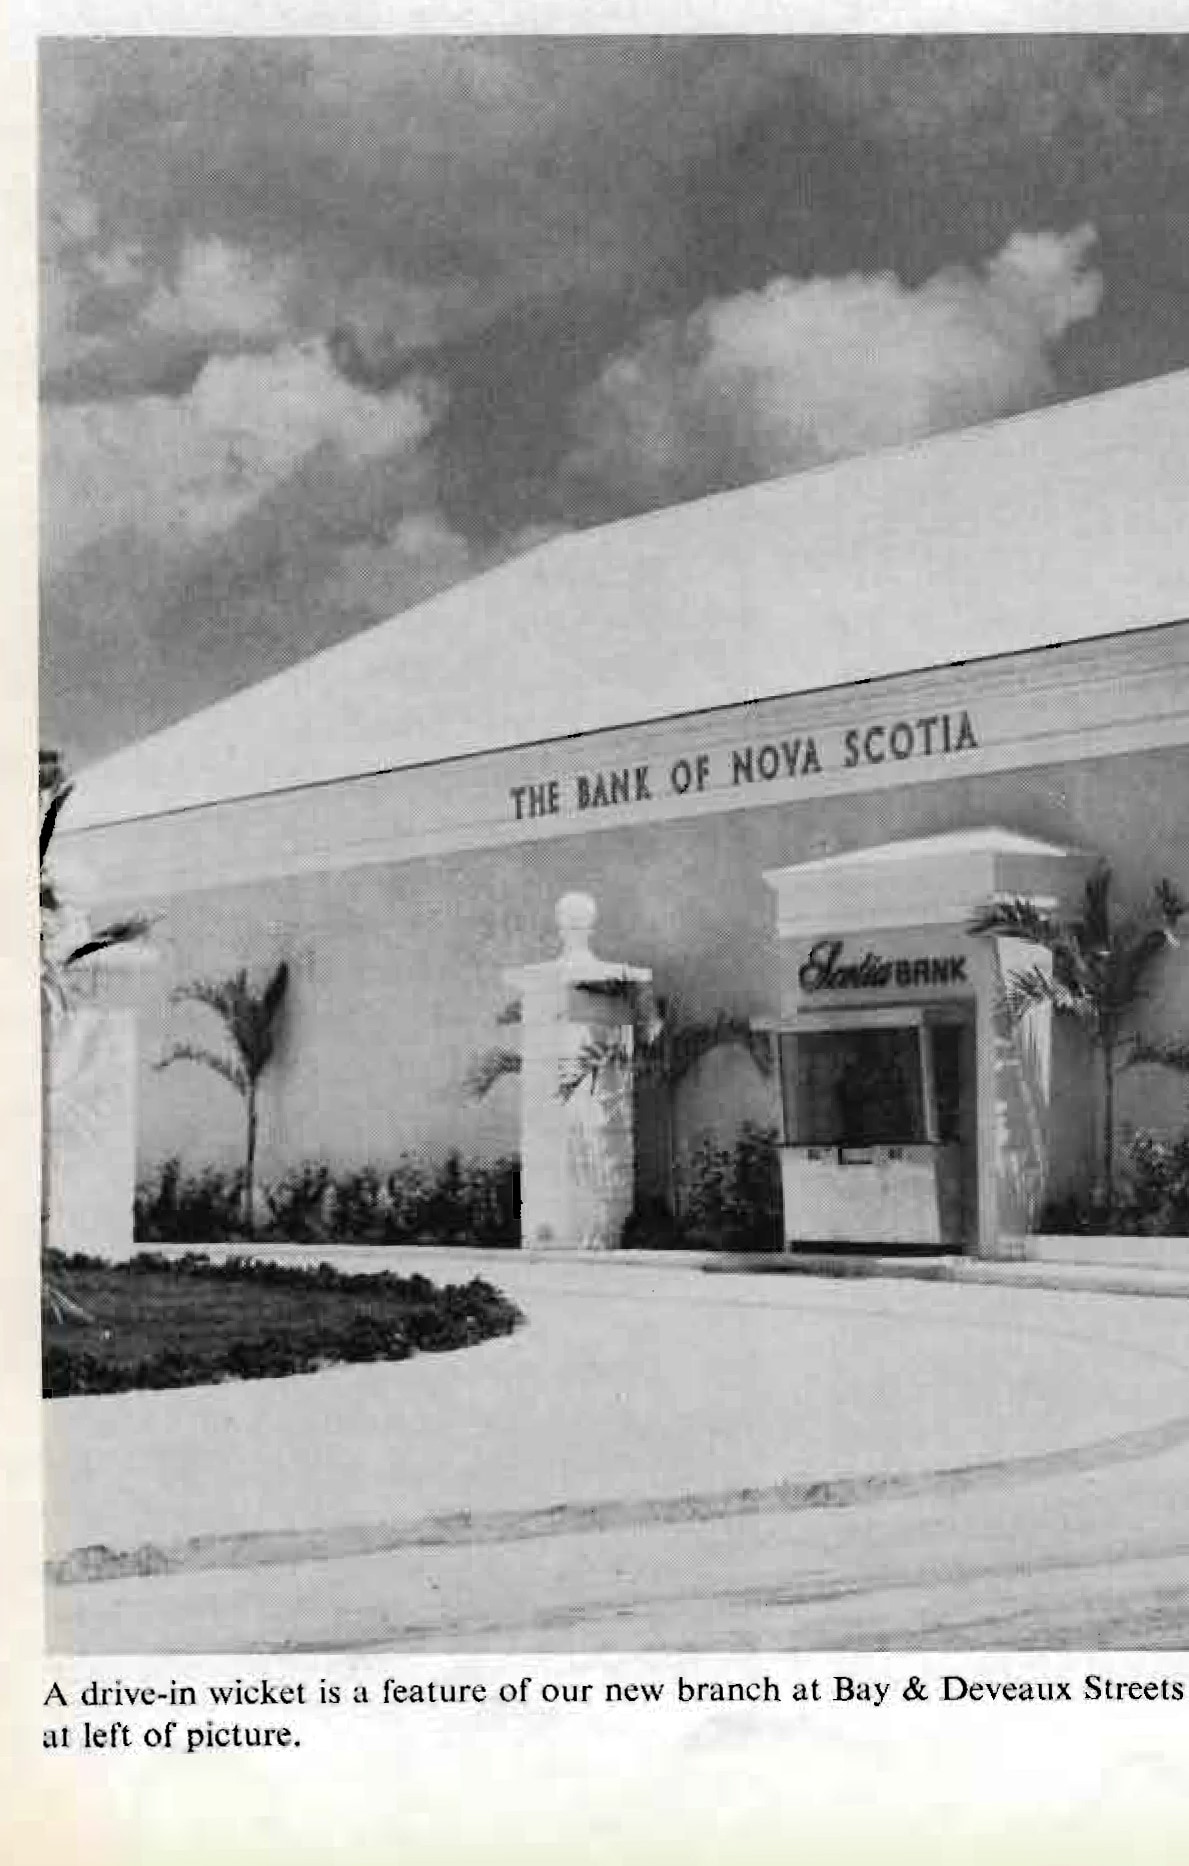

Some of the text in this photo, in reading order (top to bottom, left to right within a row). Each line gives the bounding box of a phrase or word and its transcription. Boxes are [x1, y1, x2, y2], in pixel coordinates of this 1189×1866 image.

[509, 709, 979, 820] THE BANK OF NOVA SCOTIA
